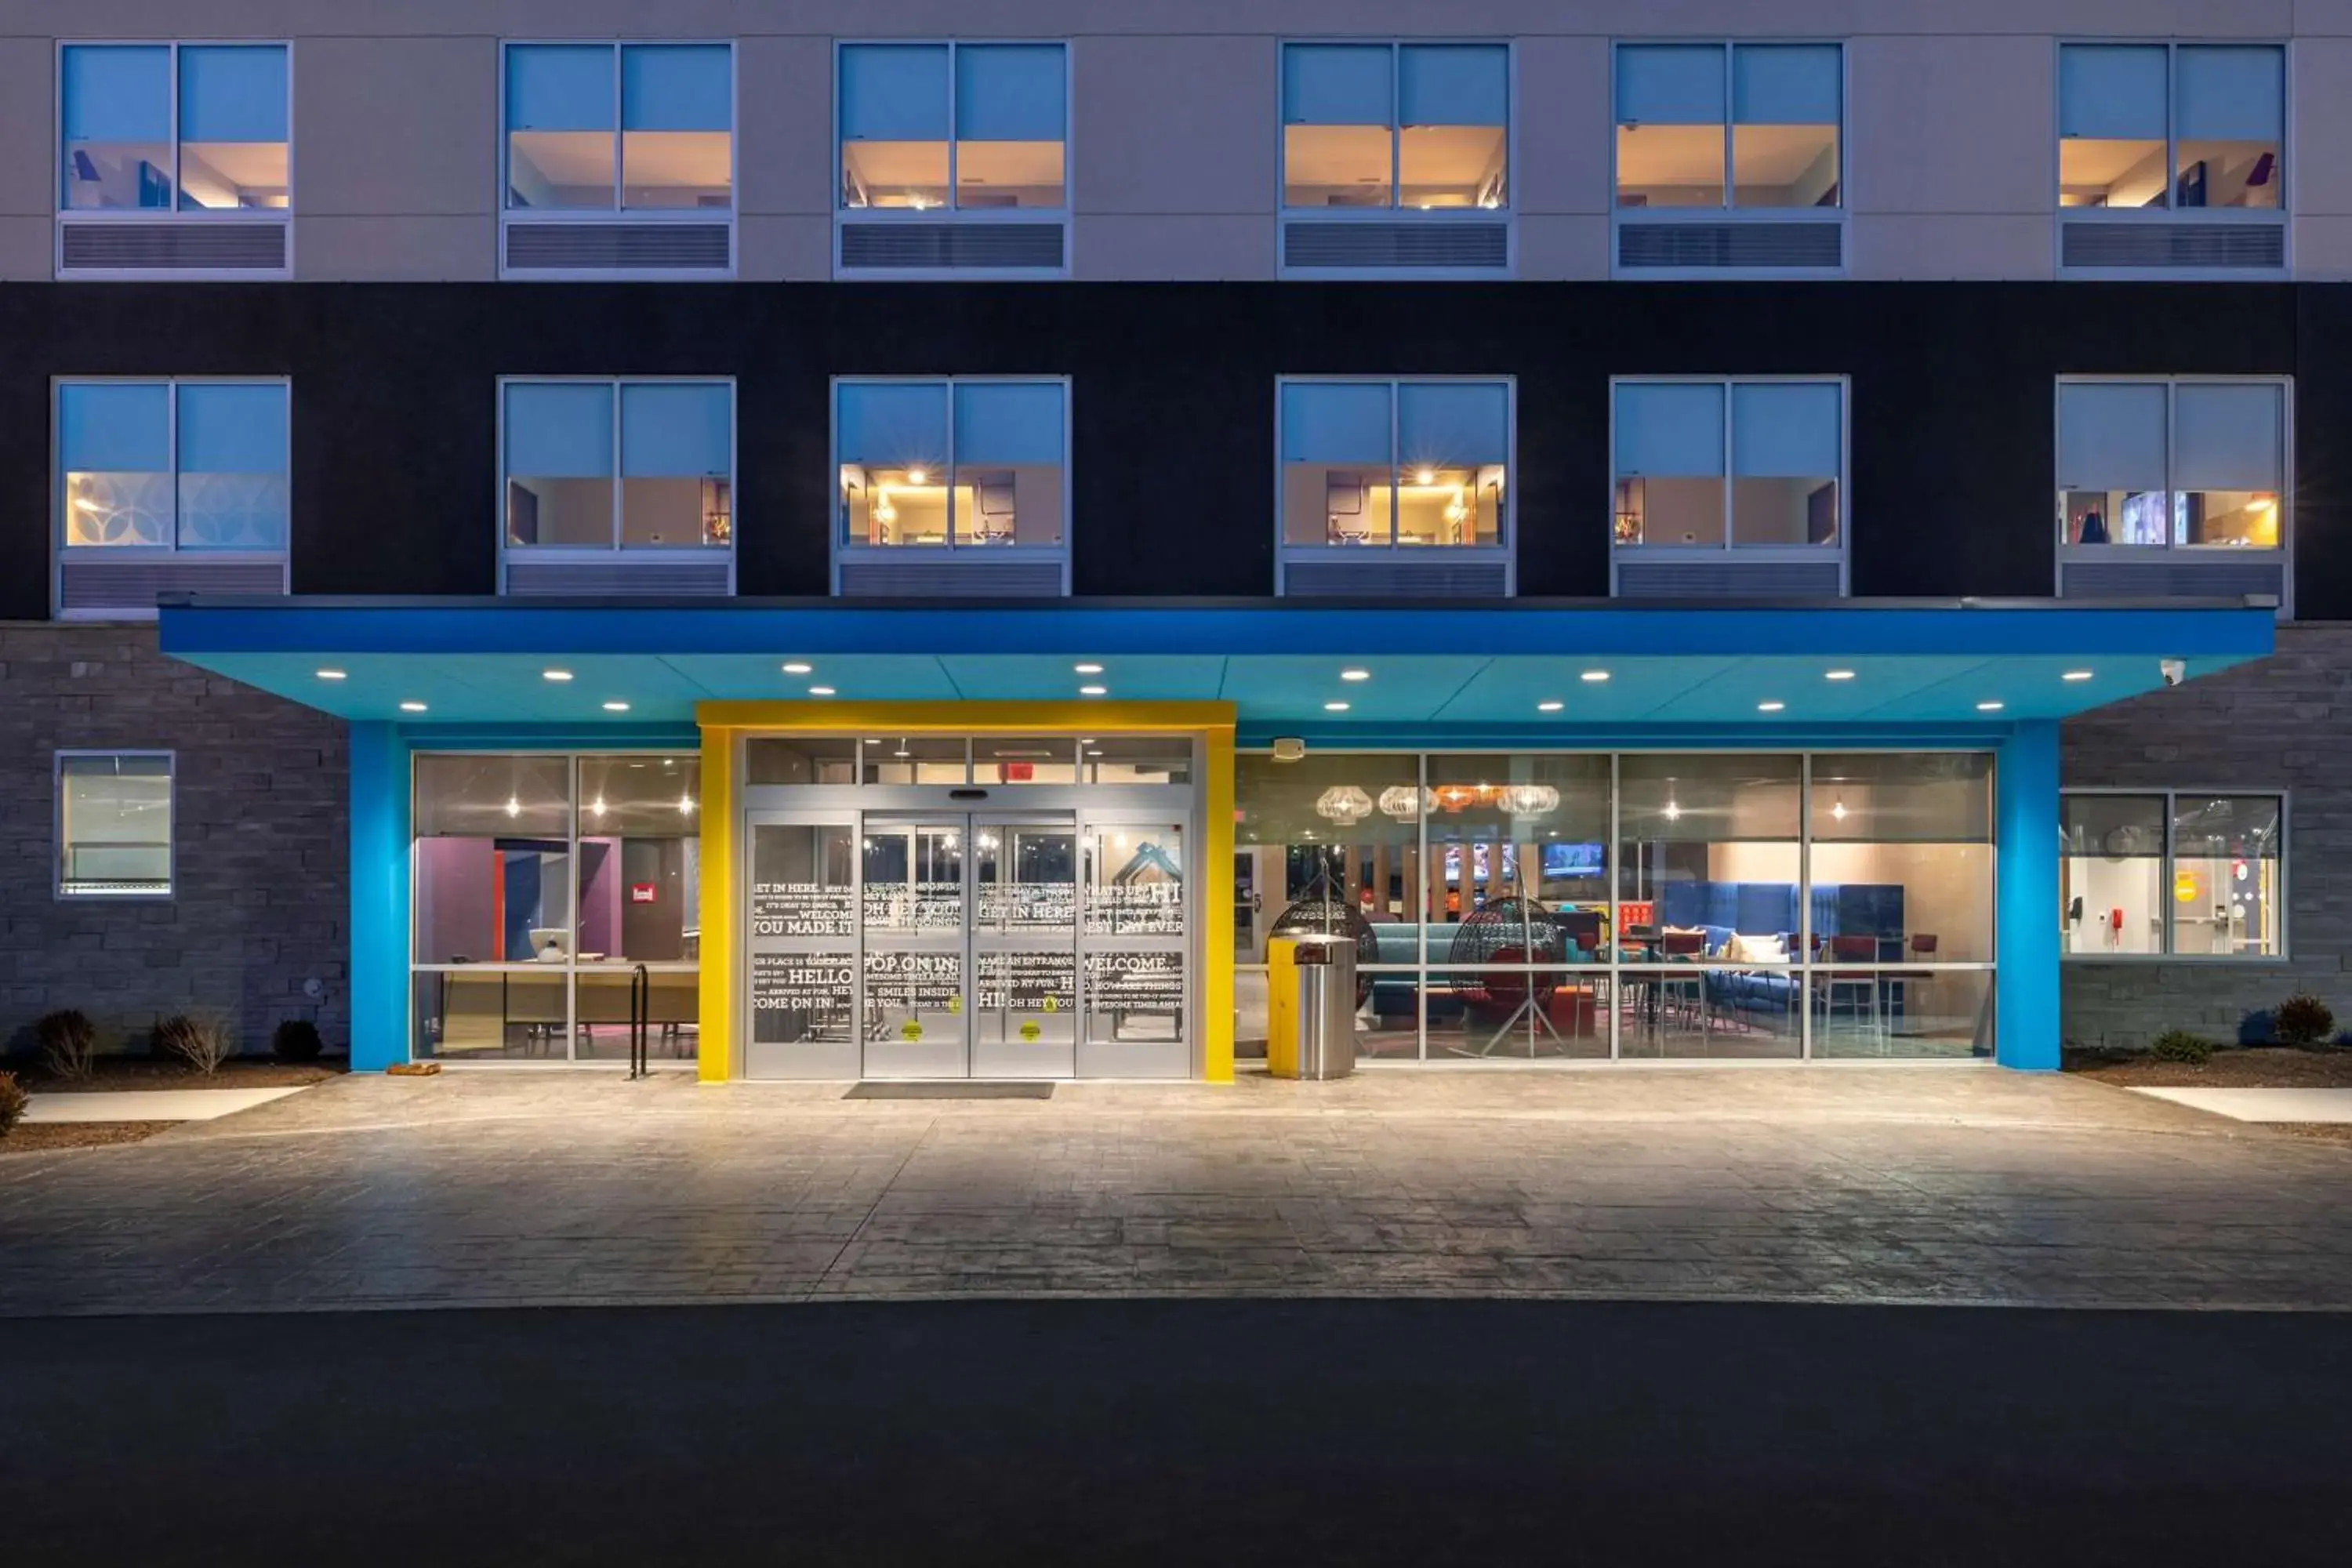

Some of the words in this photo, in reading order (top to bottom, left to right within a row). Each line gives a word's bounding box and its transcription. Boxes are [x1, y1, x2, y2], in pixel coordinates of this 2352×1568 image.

[753, 884, 771, 893] ET
[772, 884, 786, 893] IN
[1011, 906, 1029, 918] IN
[786, 920, 835, 934] MADE
[1084, 921, 1112, 933] EST
[902, 956, 932, 972] ON
[788, 968, 853, 985] HELLO
[877, 987, 916, 996] SMILES
[918, 987, 958, 996] INSIDE.
[792, 997, 811, 1009] ON
[978, 992, 1005, 1007] HI!
[1008, 998, 1025, 1007] OH
